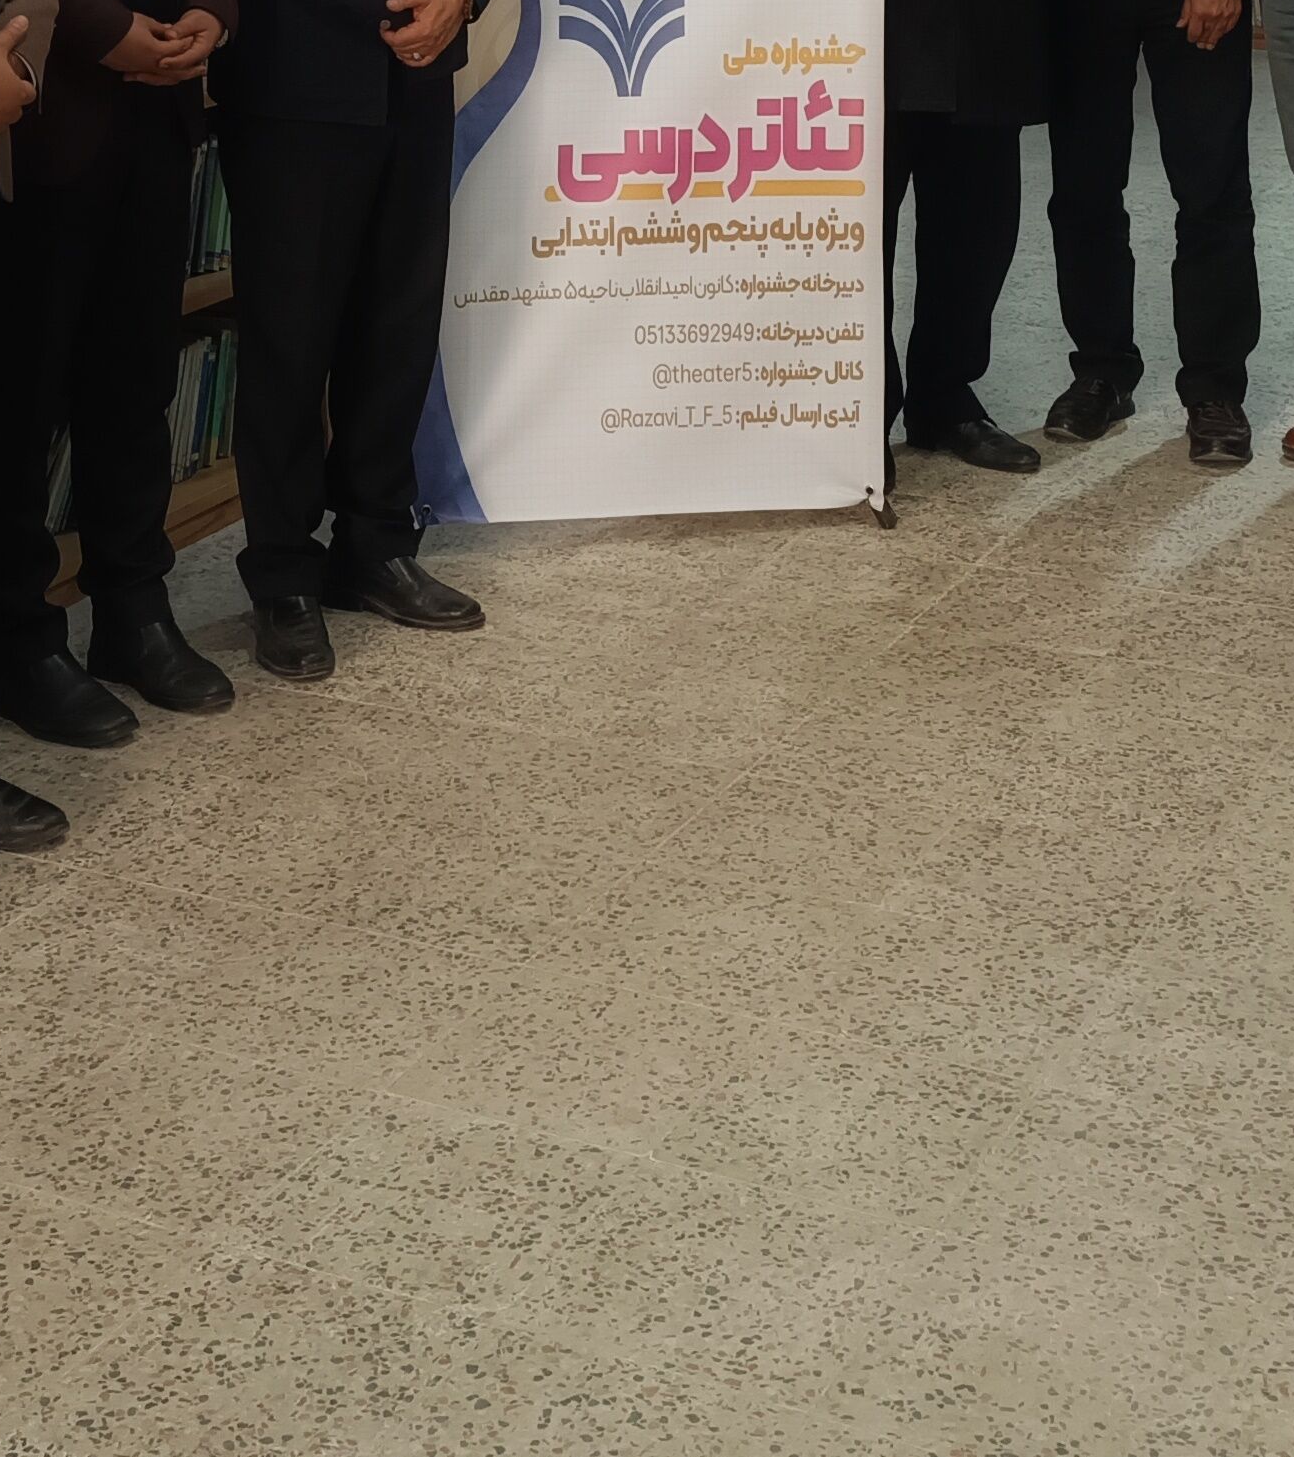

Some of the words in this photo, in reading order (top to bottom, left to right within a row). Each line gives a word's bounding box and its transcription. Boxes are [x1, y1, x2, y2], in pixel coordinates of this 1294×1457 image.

[723, 38, 768, 76] ملی
[771, 34, 866, 75] جشنواره
[728, 79, 865, 203] تئاتر
[557, 113, 731, 205] درسی
[531, 216, 615, 258] ابتدایی
[617, 210, 685, 256] ششم
[702, 215, 768, 258] پنجم
[769, 211, 814, 258] پایه
[815, 207, 865, 253] ویژه
[454, 285, 510, 309] مقدس
[511, 281, 563, 307] مشهد
[564, 280, 577, 300] ۵
[578, 279, 619, 304] ناحیه
[619, 276, 662, 302] انقلاب
[662, 275, 693, 300] امید
[694, 274, 735, 300] کانون
[735, 272, 801, 300] جشنواره:
[801, 272, 865, 299] دبیرخانه
[634, 322, 755, 345] 05133692949
[756, 321, 825, 347] دبیرخانه:
[826, 322, 864, 345] تلفن
[652, 362, 753, 390] @theater5
[755, 360, 823, 388] جشنواره:
[825, 361, 864, 385] کانال
[601, 404, 733, 434] @Razavi_T_F_5
[736, 400, 778, 430] فیلم:
[780, 403, 822, 430] ارسال
[824, 400, 861, 429] آیدی
